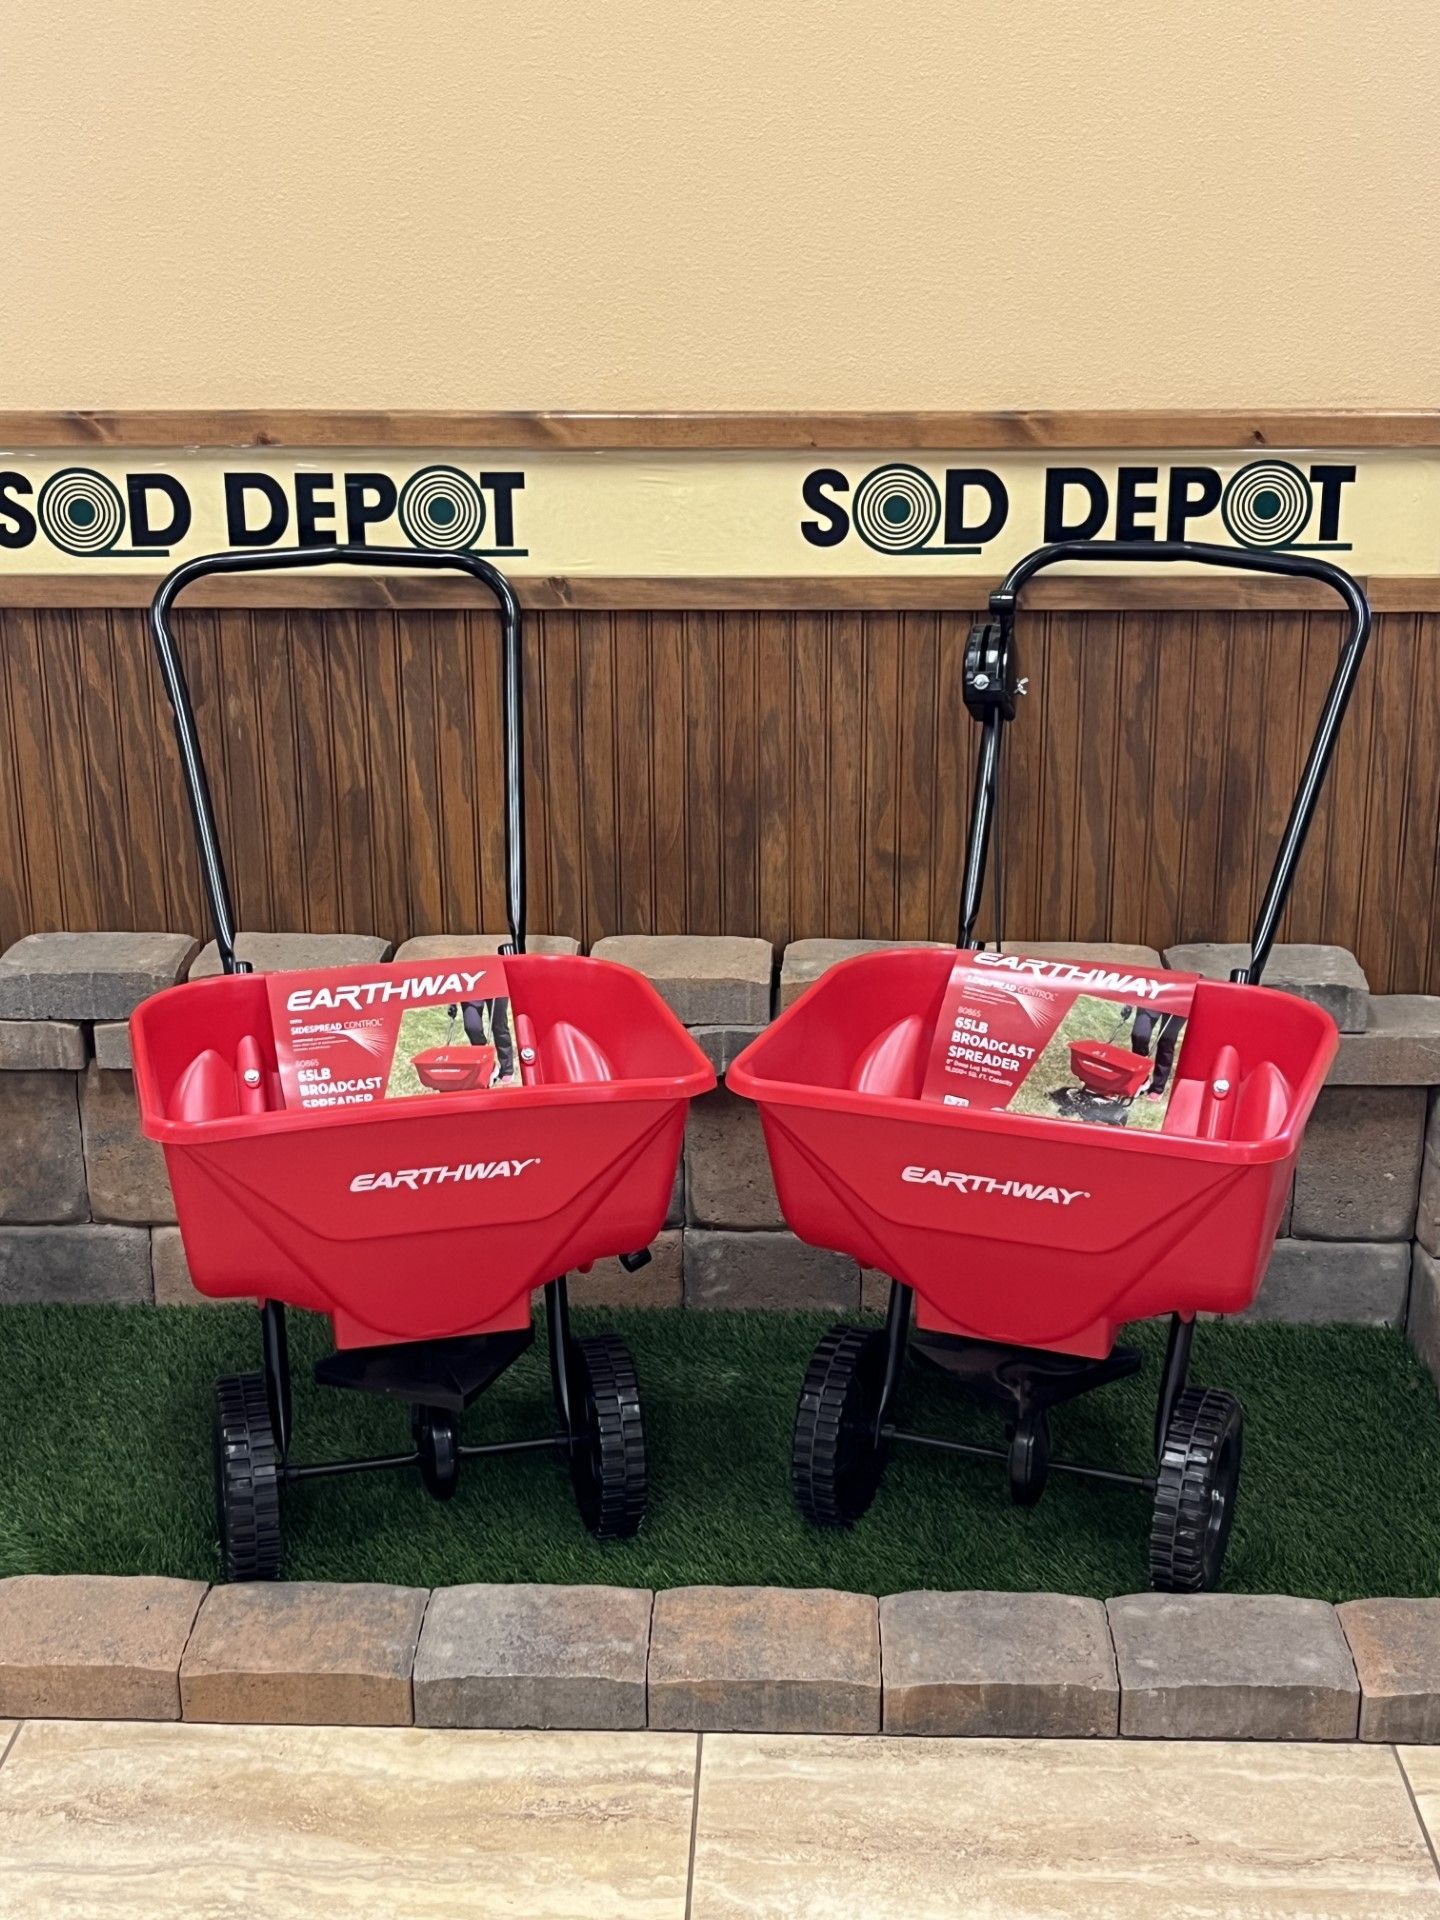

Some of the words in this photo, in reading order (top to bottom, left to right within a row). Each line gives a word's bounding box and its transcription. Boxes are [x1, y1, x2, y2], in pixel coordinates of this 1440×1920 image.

[0, 467, 191, 557] SOD
[224, 465, 528, 556] DEPOT
[801, 463, 1008, 555] SOD
[1043, 460, 1356, 551] DEPOT
[287, 970, 486, 1012] EARTHWAY
[973, 952, 1176, 1000] EARTHWAY
[291, 1023, 342, 1035] SIDESPREAD
[955, 1017, 988, 1034] 65LB
[948, 1046, 1020, 1072] SPREADER
[951, 1030, 1035, 1060] BROADCAST
[298, 1067, 331, 1082] 65LB
[300, 1077, 382, 1096] BROADCAST
[350, 1158, 535, 1192] EARTHWAY
[901, 1166, 1084, 1205] EARTHWAY
